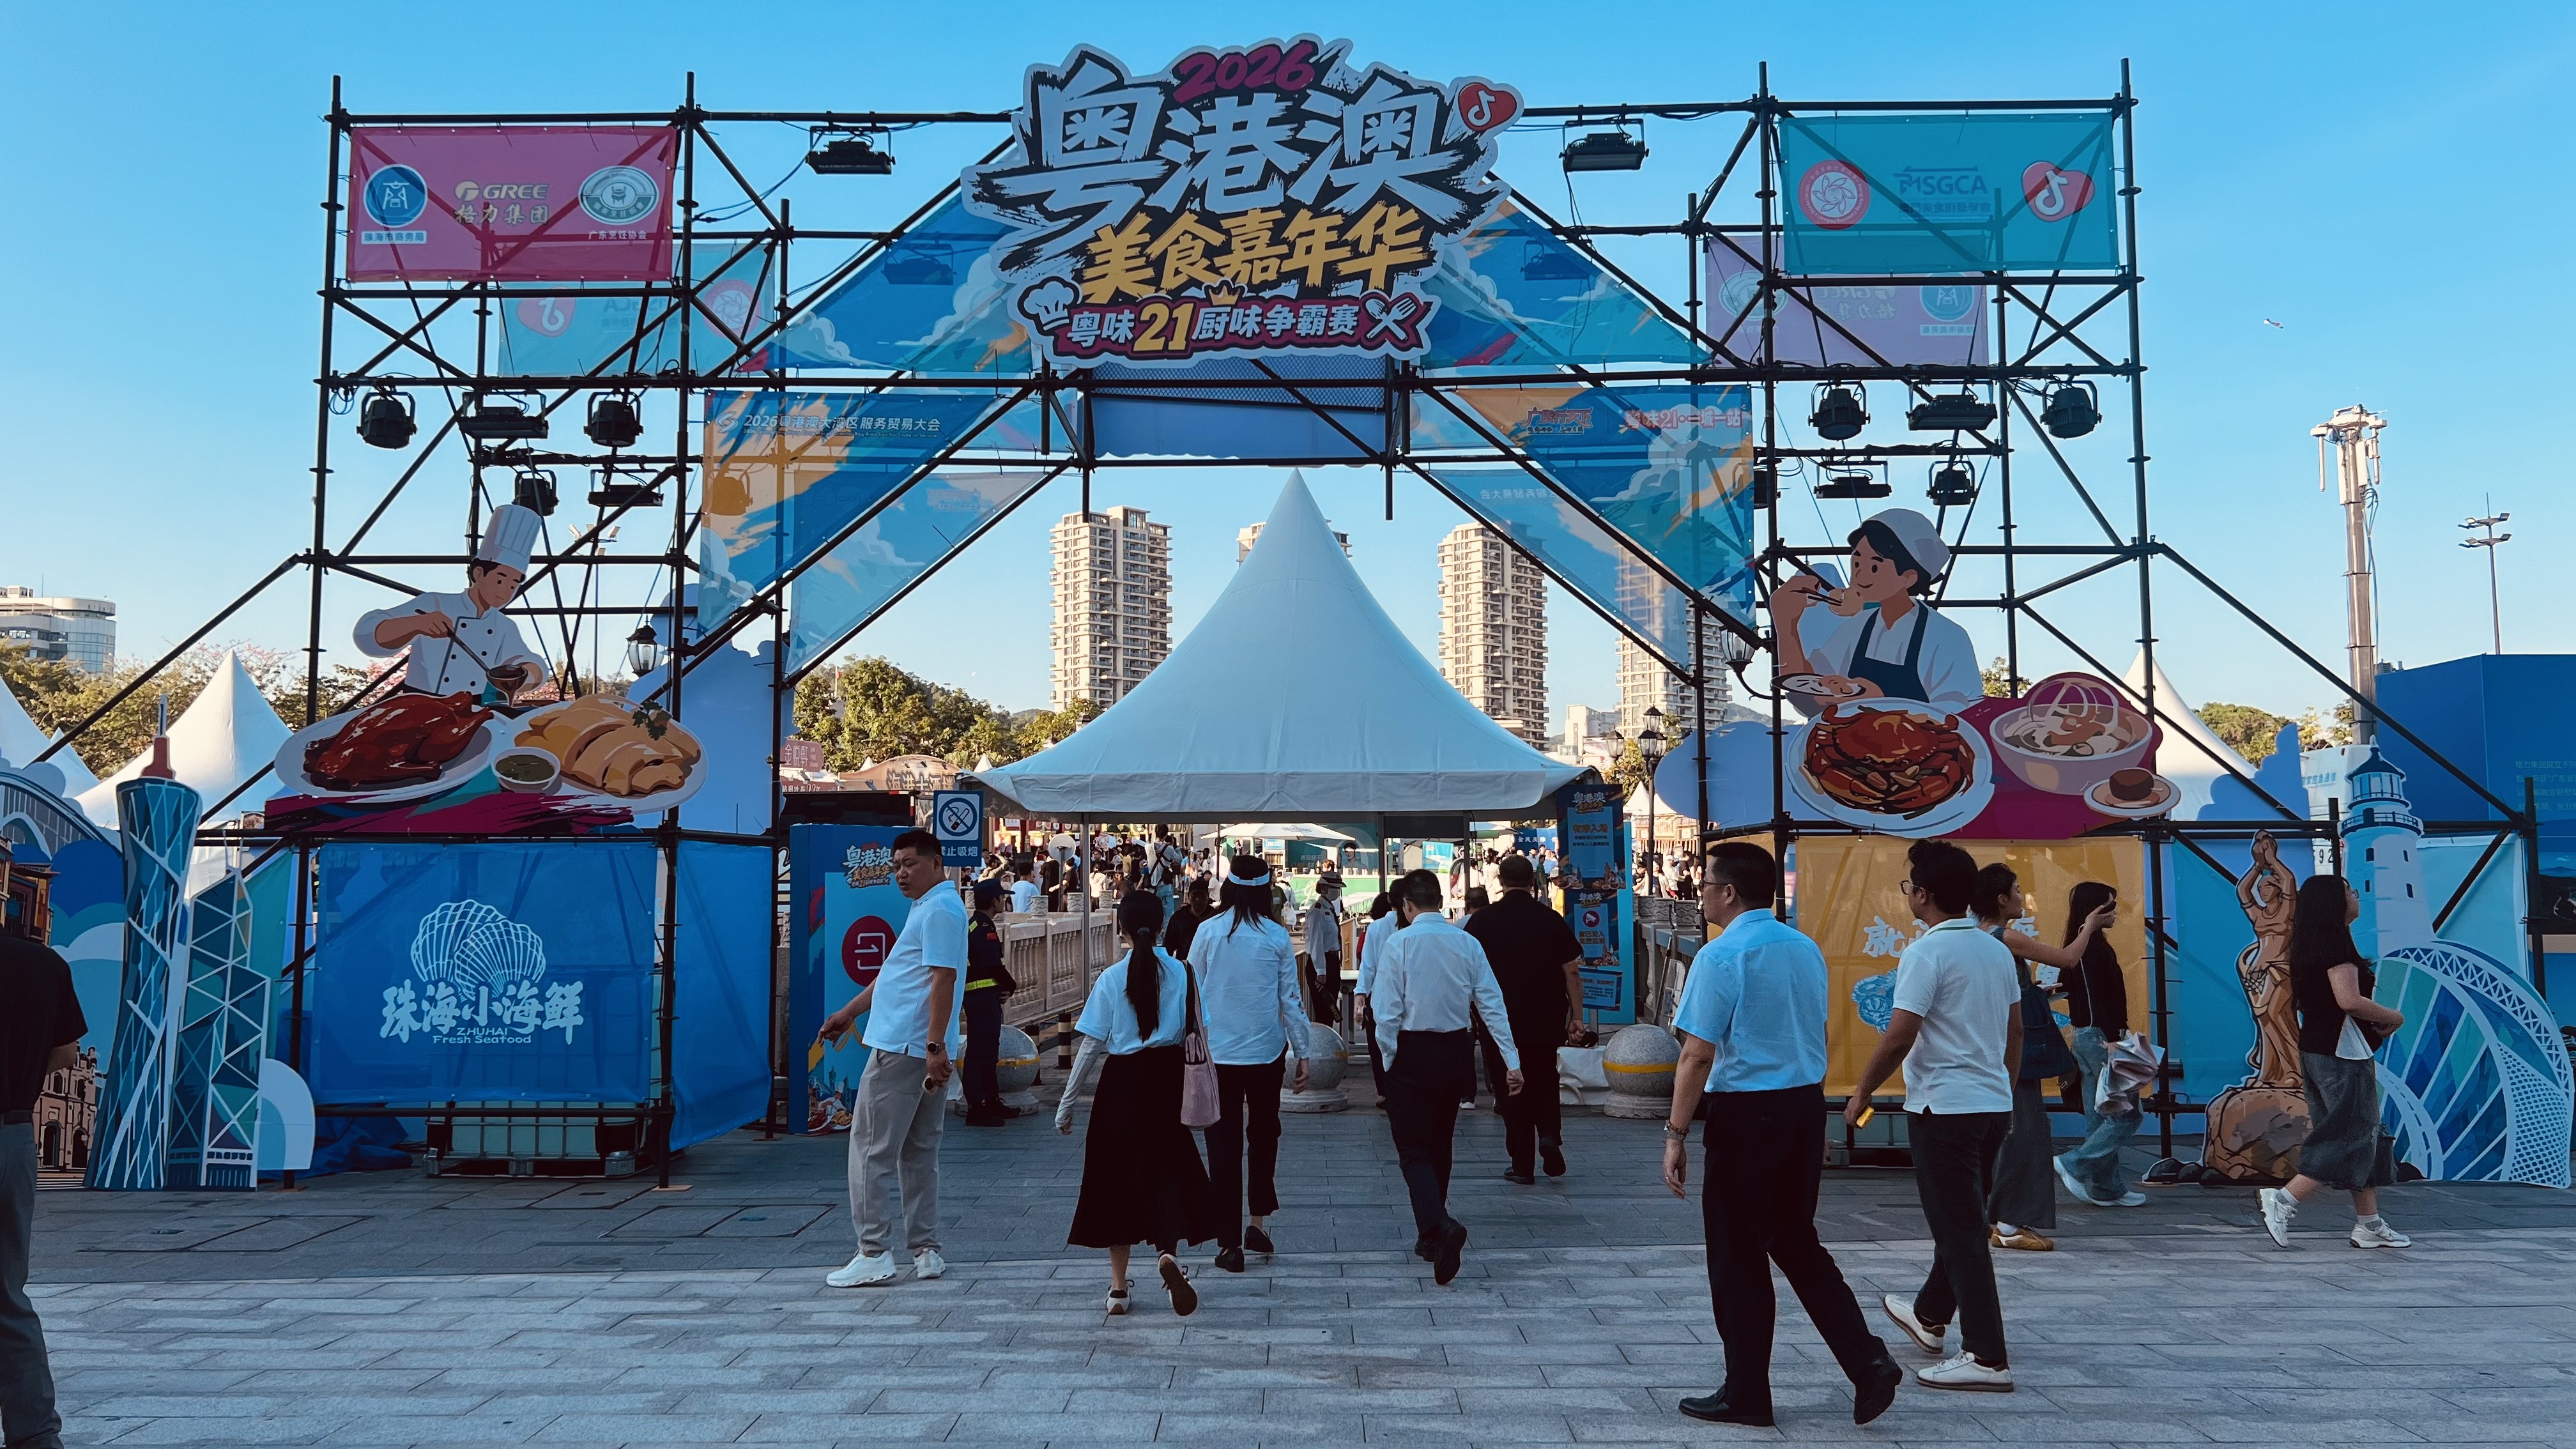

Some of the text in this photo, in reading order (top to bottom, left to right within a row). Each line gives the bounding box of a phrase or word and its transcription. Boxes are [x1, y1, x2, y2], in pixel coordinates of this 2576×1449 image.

[1173, 40, 1321, 103] 2026
[984, 57, 1485, 263] 粤港澳
[482, 184, 549, 200] GREE
[453, 204, 550, 226] 格力集团
[364, 232, 425, 243] 珠海市商务局
[588, 230, 647, 240] 广东烹饪协会
[1082, 204, 1436, 303] 美食嘉年华
[1067, 302, 1359, 352] 粤味21厨味争霸赛
[842, 845, 894, 875] 粤港澳
[379, 978, 584, 1045] 珠海小海鲜
[433, 1034, 532, 1045] Fresh Seafood
[456, 1027, 508, 1036] ZHUHAI
